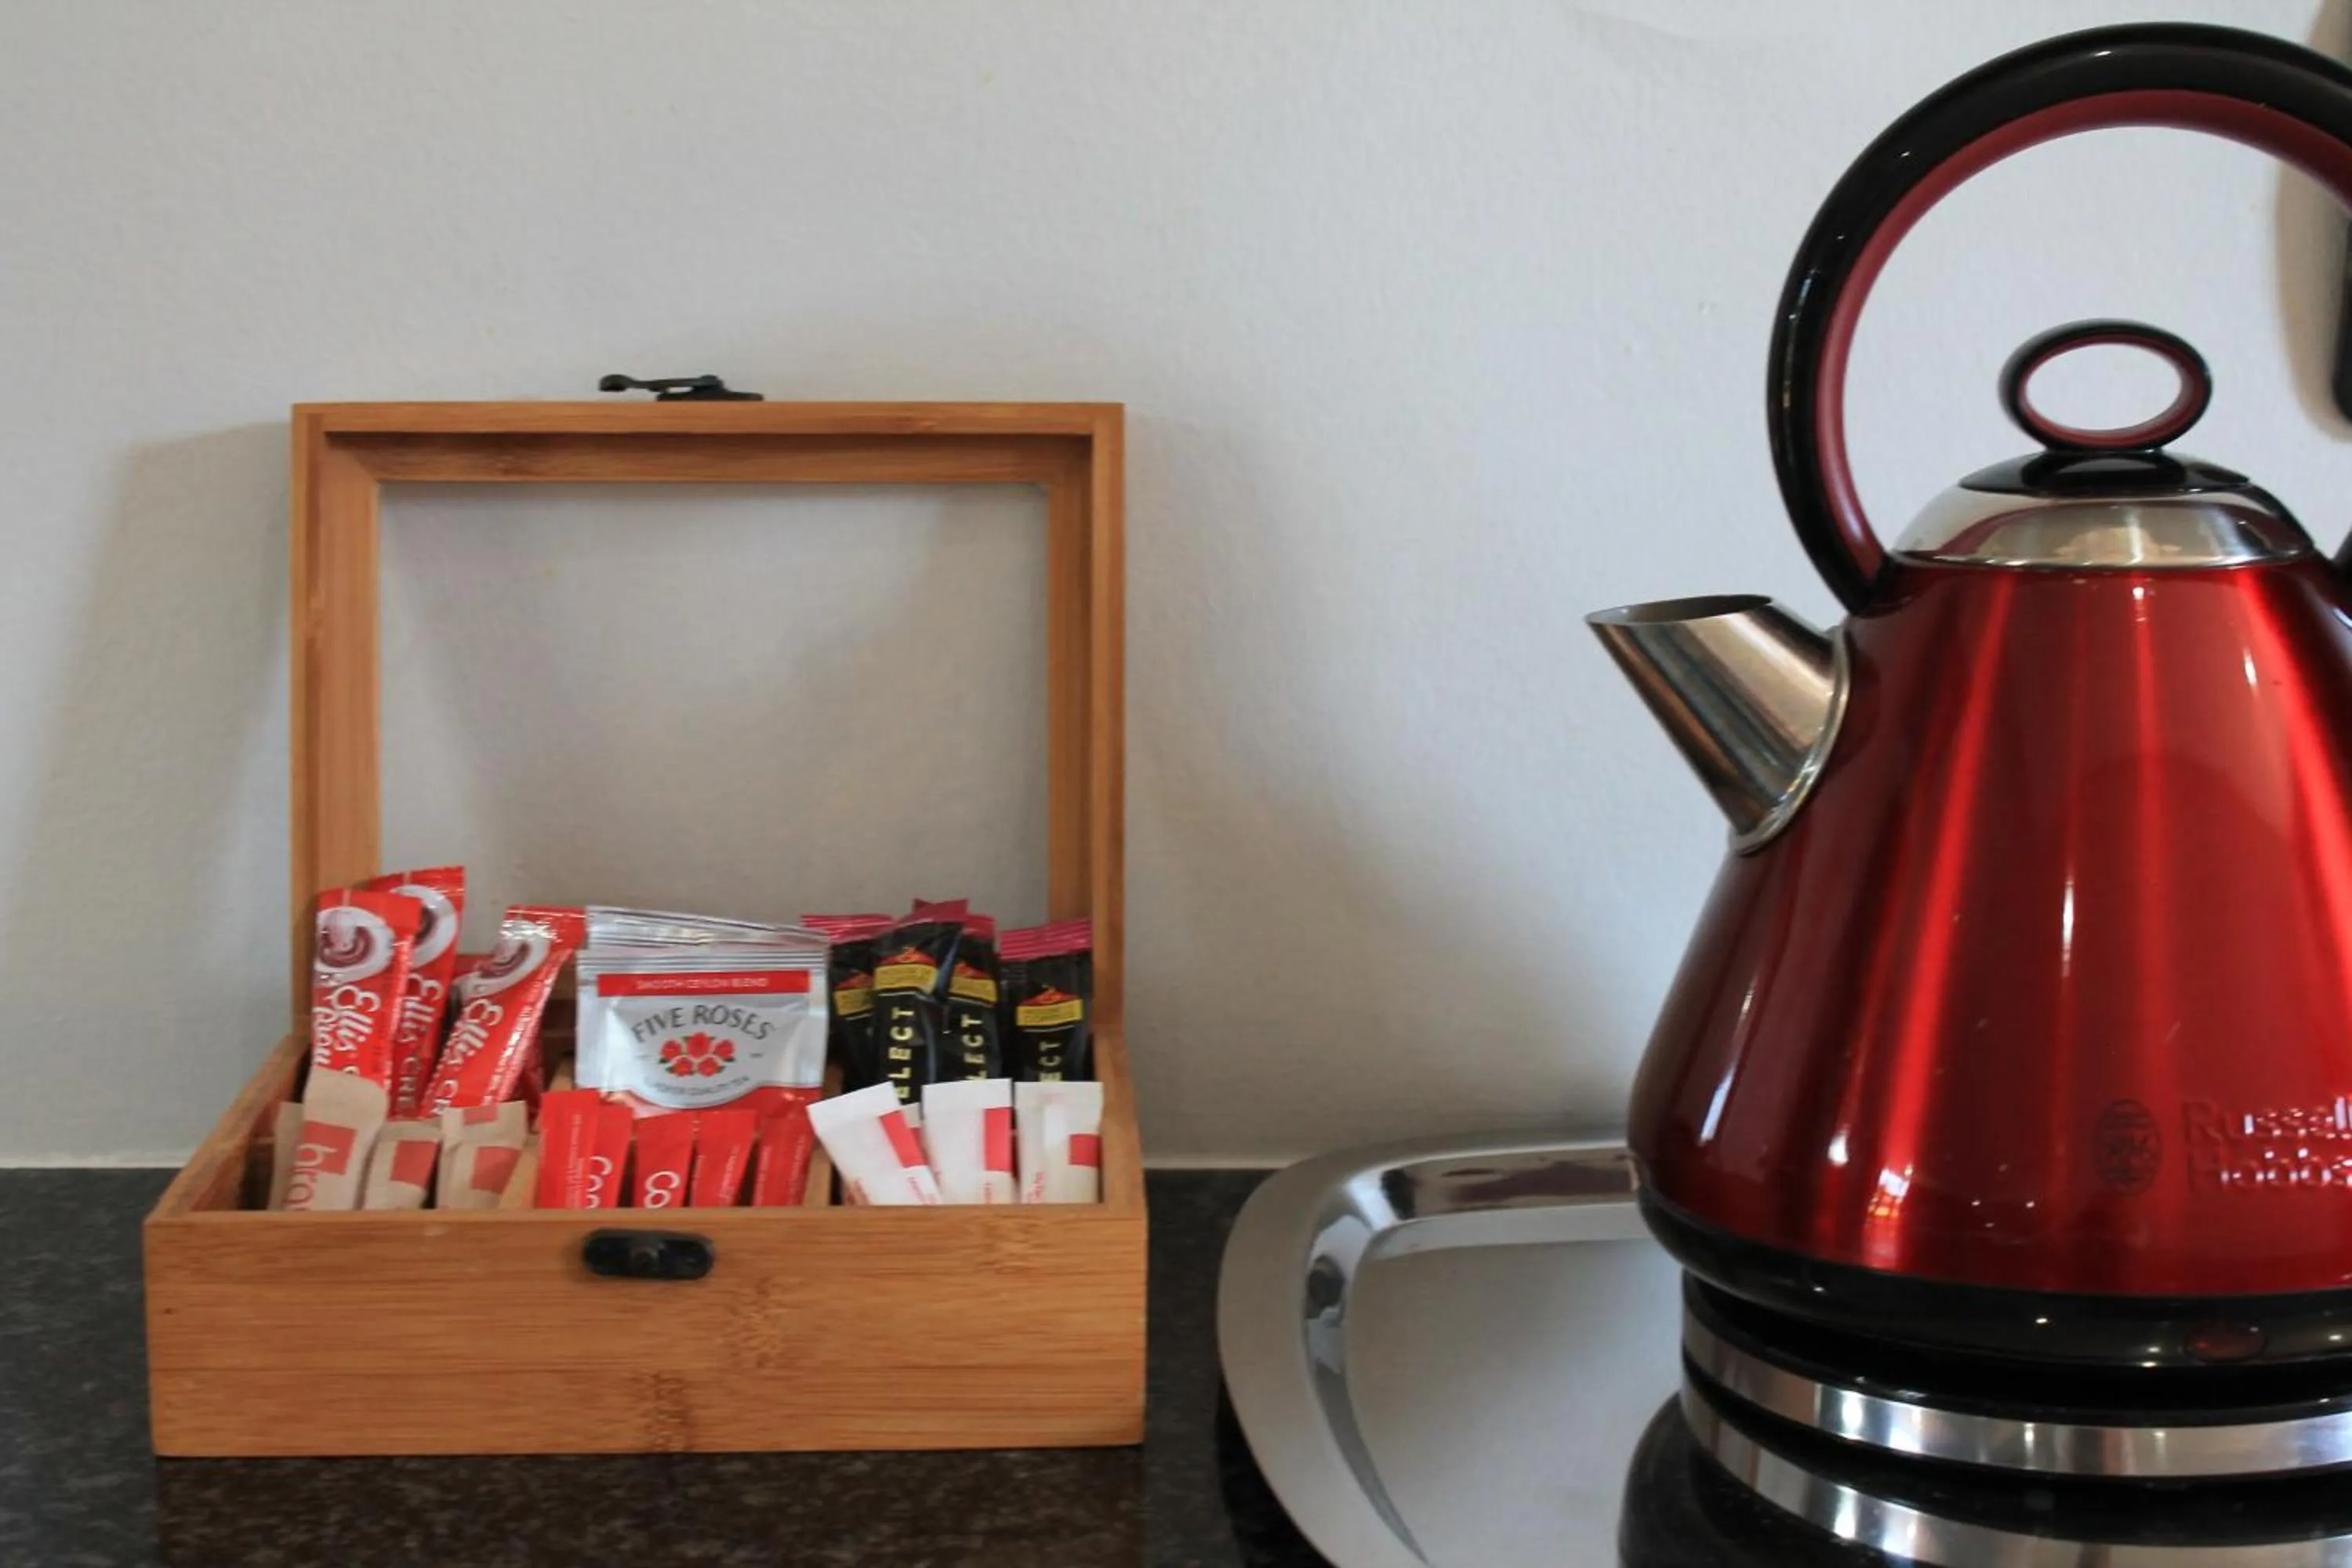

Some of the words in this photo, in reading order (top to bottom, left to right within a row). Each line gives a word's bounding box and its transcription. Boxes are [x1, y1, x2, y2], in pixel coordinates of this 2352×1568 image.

[324, 984, 382, 1052] Ellis
[399, 973, 444, 1044] Ellis
[445, 997, 505, 1066] Ellis
[631, 1007, 686, 1044] FIVE
[692, 1004, 772, 1040] ROSES
[887, 1006, 916, 1099] ELECT
[960, 1013, 988, 1080] LECT
[1038, 1040, 1063, 1082] ECT
[397, 1055, 420, 1109] CRE
[281, 1142, 339, 1211] bro
